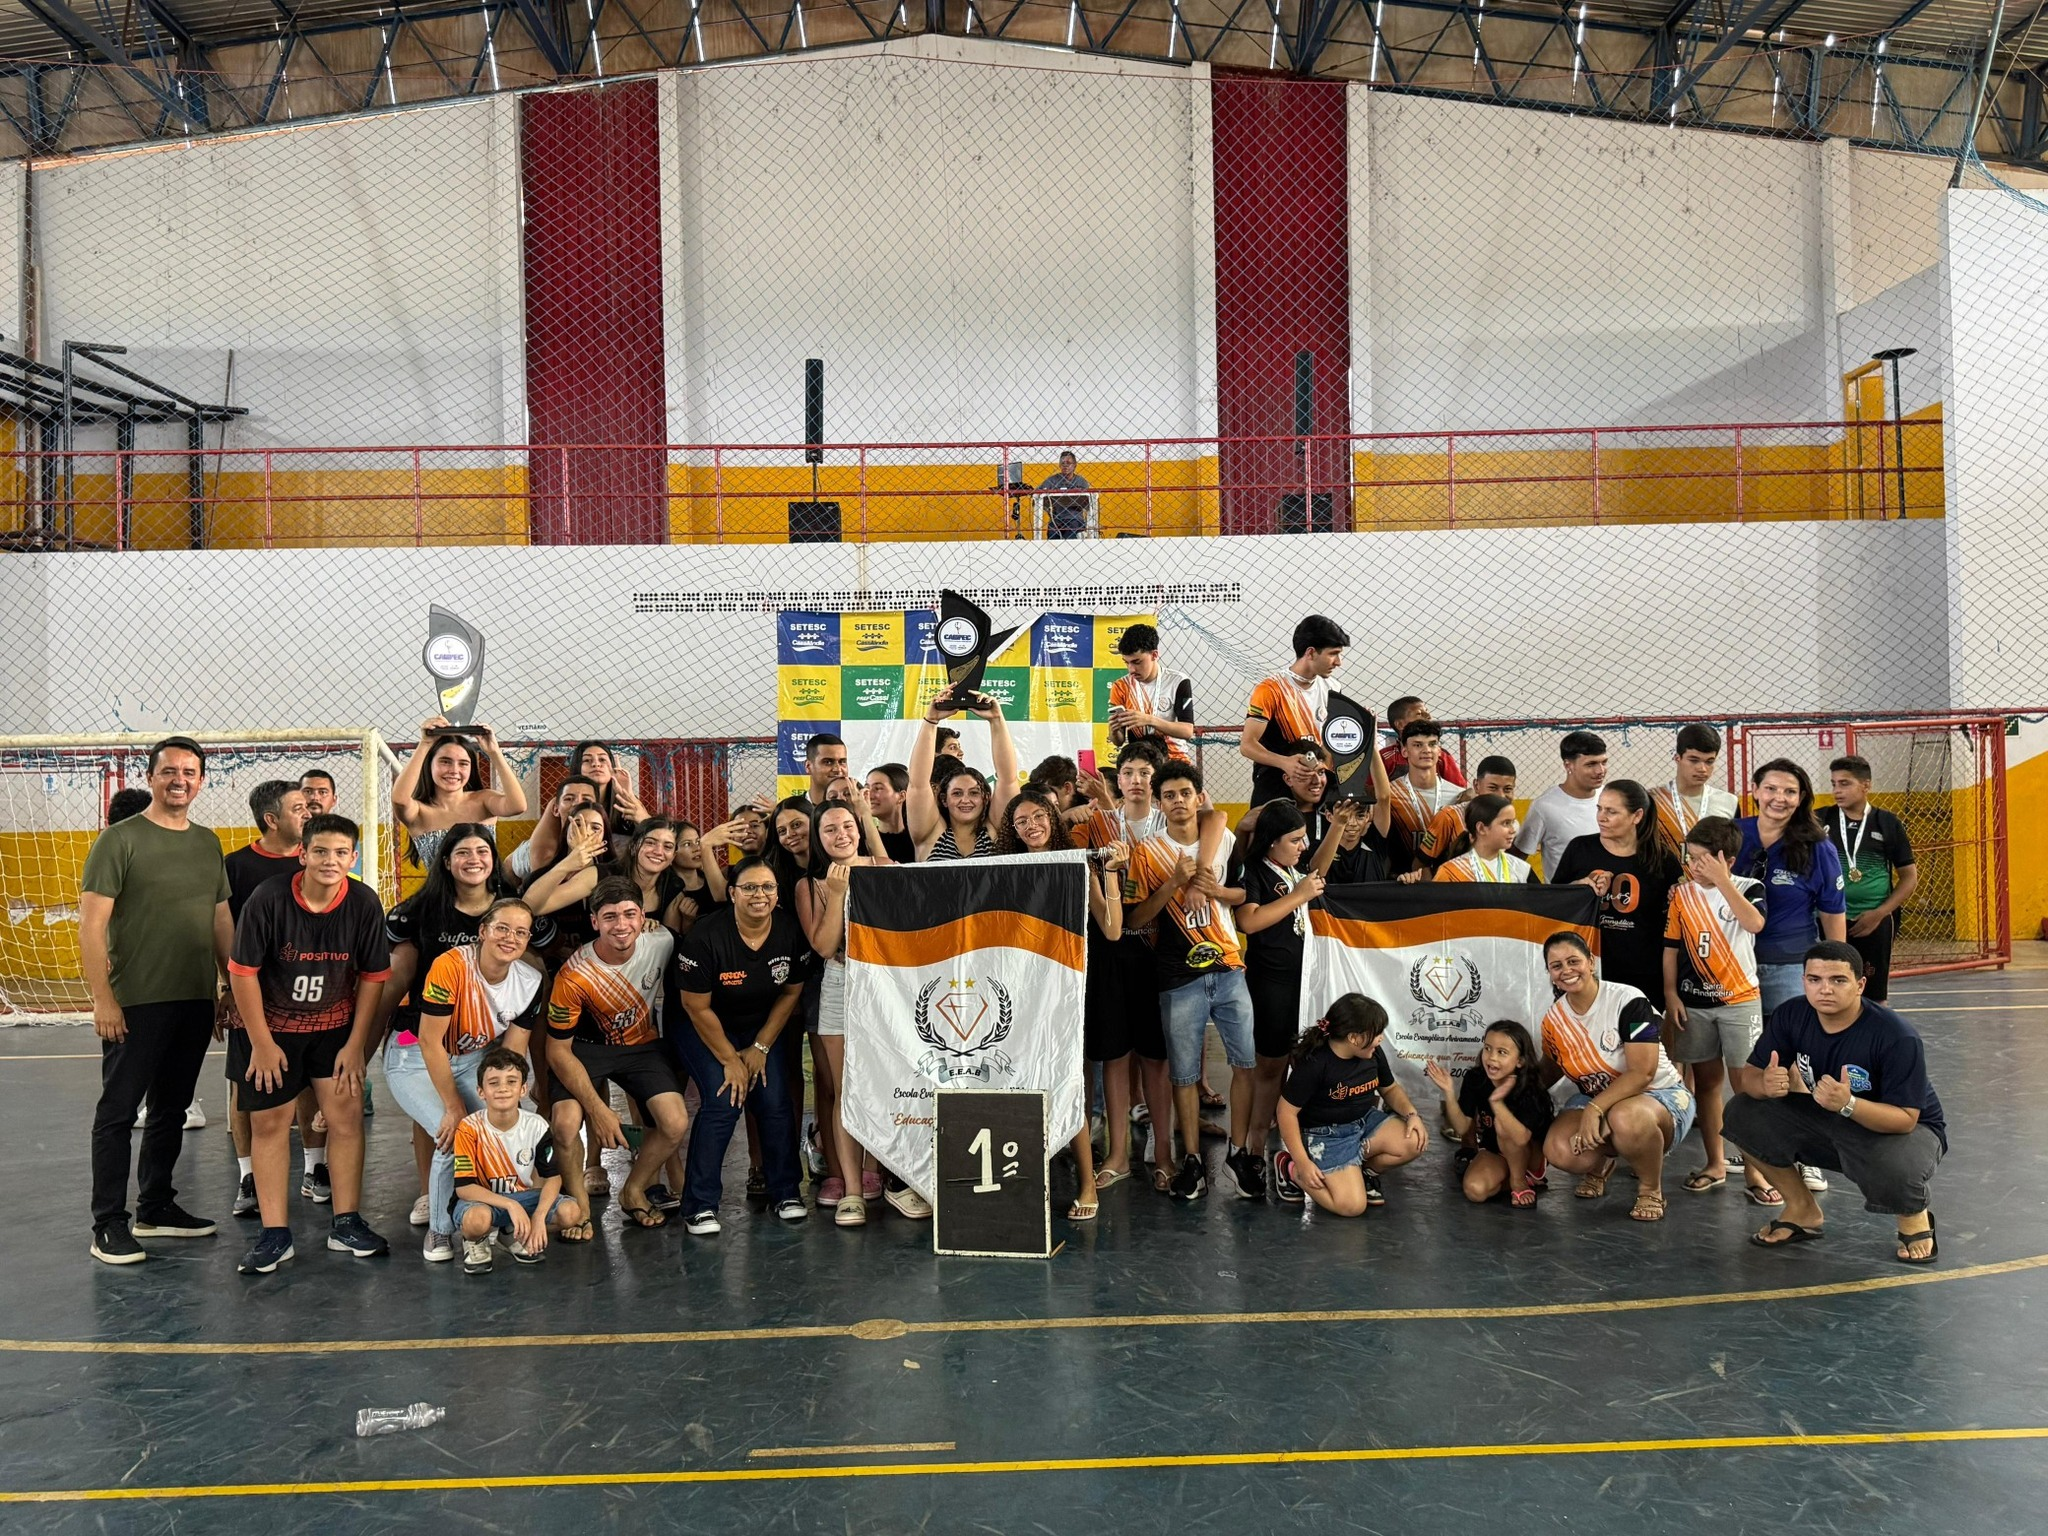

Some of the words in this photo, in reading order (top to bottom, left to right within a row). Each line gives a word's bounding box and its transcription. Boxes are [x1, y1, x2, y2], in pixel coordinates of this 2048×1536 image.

[854, 623, 891, 631] SETESC
[1044, 625, 1080, 633] SETESC
[918, 678, 949, 686] SETES
[1044, 680, 1079, 688] SETESC
[1698, 931, 1711, 958] 5
[300, 951, 349, 961] POSITIVO
[291, 975, 325, 1003] 95
[1693, 989, 1734, 997] Financeira
[1396, 1032, 1413, 1041] Escola
[948, 1068, 981, 1077] E.E.A.B
[1349, 1077, 1380, 1097] POSITIV
[893, 1087, 919, 1099] Escola
[968, 1128, 1018, 1193] 1º
